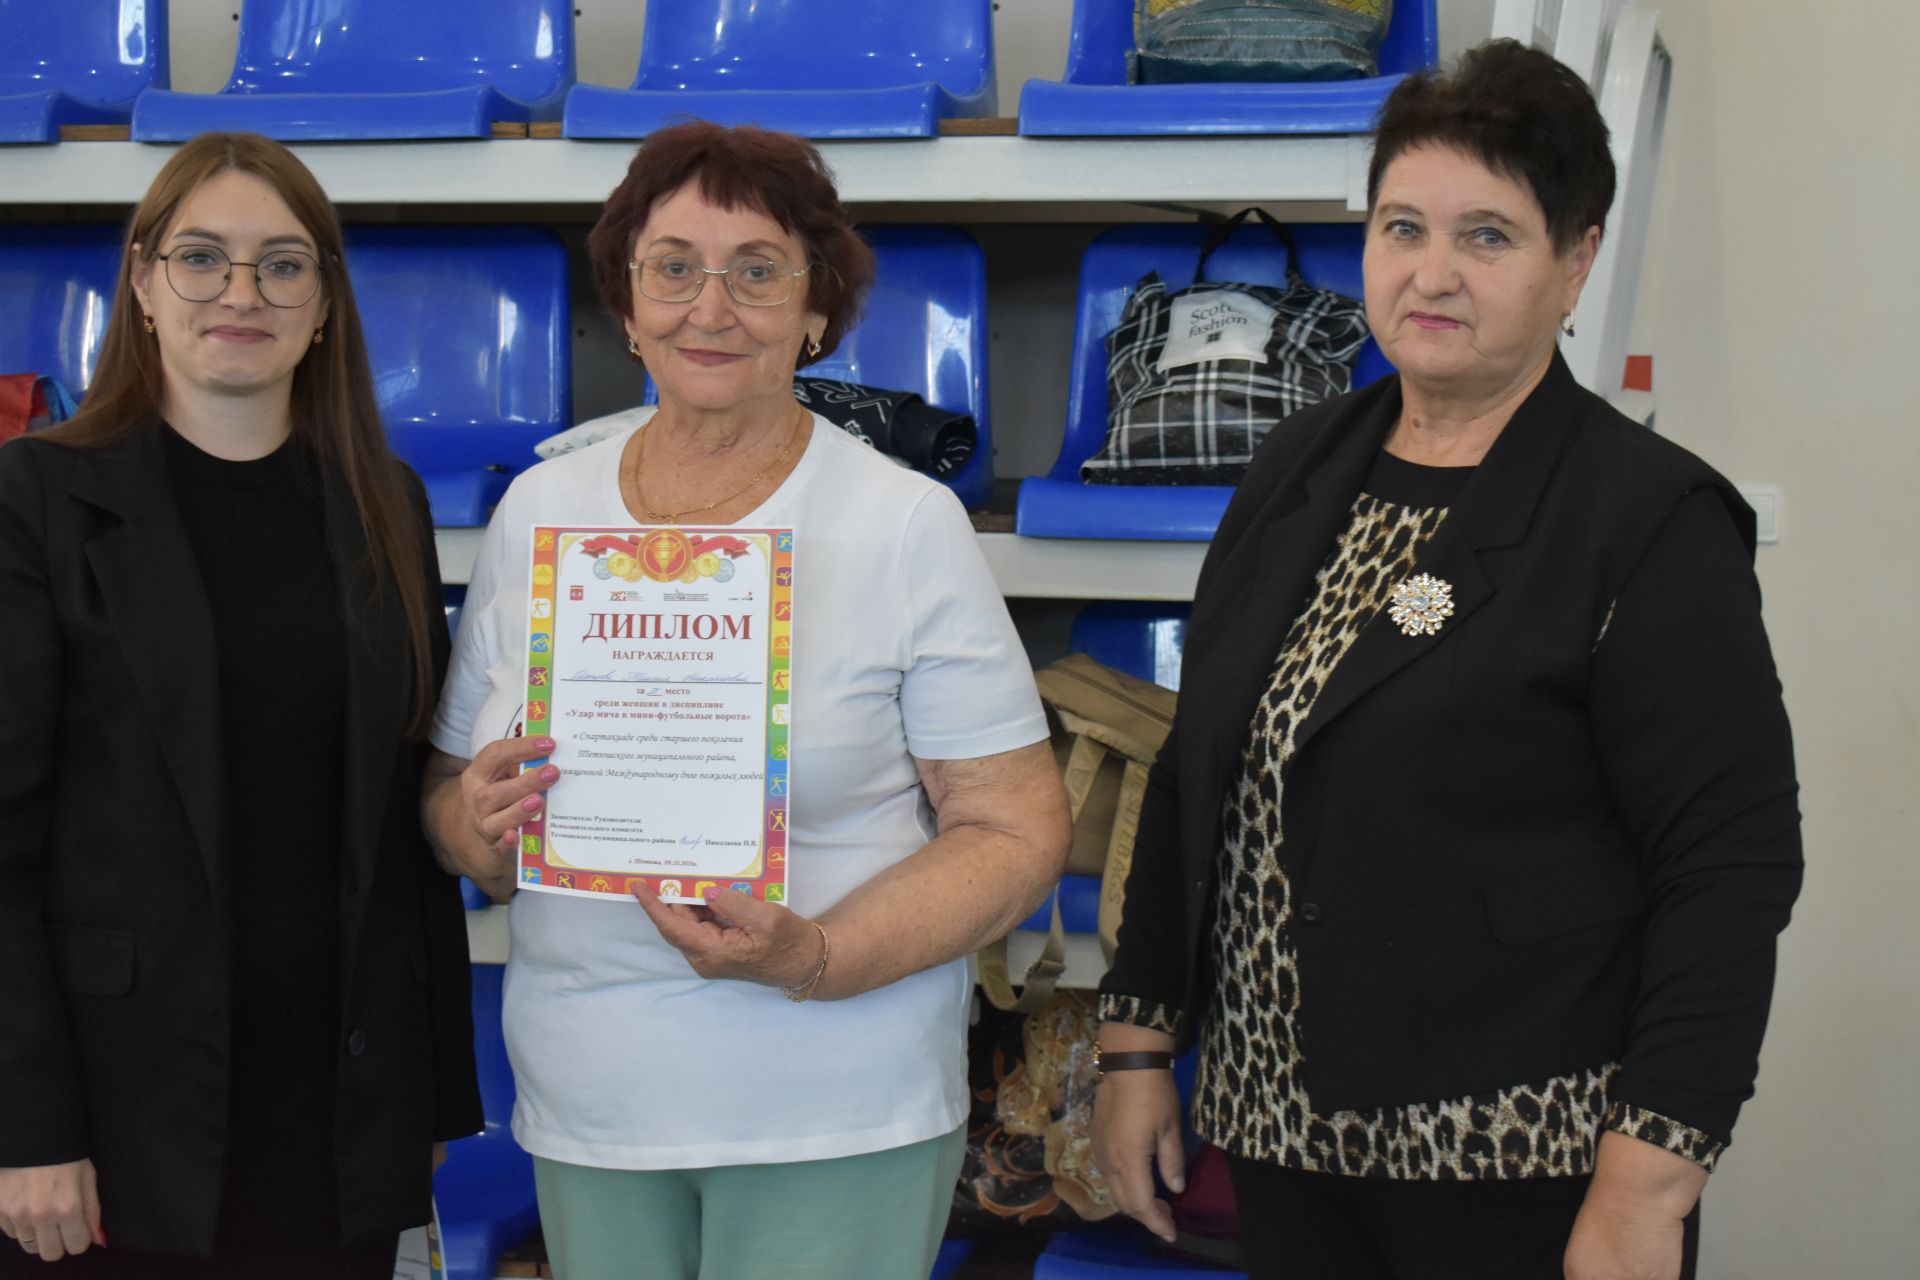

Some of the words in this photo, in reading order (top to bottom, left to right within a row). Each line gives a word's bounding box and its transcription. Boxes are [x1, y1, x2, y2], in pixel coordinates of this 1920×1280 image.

[1188, 314, 1248, 338] fashion
[583, 613, 752, 644] ДИПЛОМ
[612, 650, 714, 661] НАГРАЖДАЕТСЯ
[594, 699, 620, 709] среди
[621, 701, 659, 709] женщин
[669, 702, 724, 710] дисциплине
[565, 710, 594, 720] «Удар
[597, 711, 619, 719] мяча
[630, 712, 713, 722] мини-футбольные
[715, 713, 751, 722] ворота»
[579, 731, 635, 743] Спартакиаде
[636, 733, 658, 744] среди
[660, 735, 699, 744] старшего
[701, 736, 743, 744] поколения
[636, 751, 704, 762] муниципального
[558, 768, 604, 776] священной
[605, 768, 679, 781] Международному
[680, 770, 698, 779] дню
[700, 773, 738, 781] пожилых
[738, 770, 764, 780] людей
